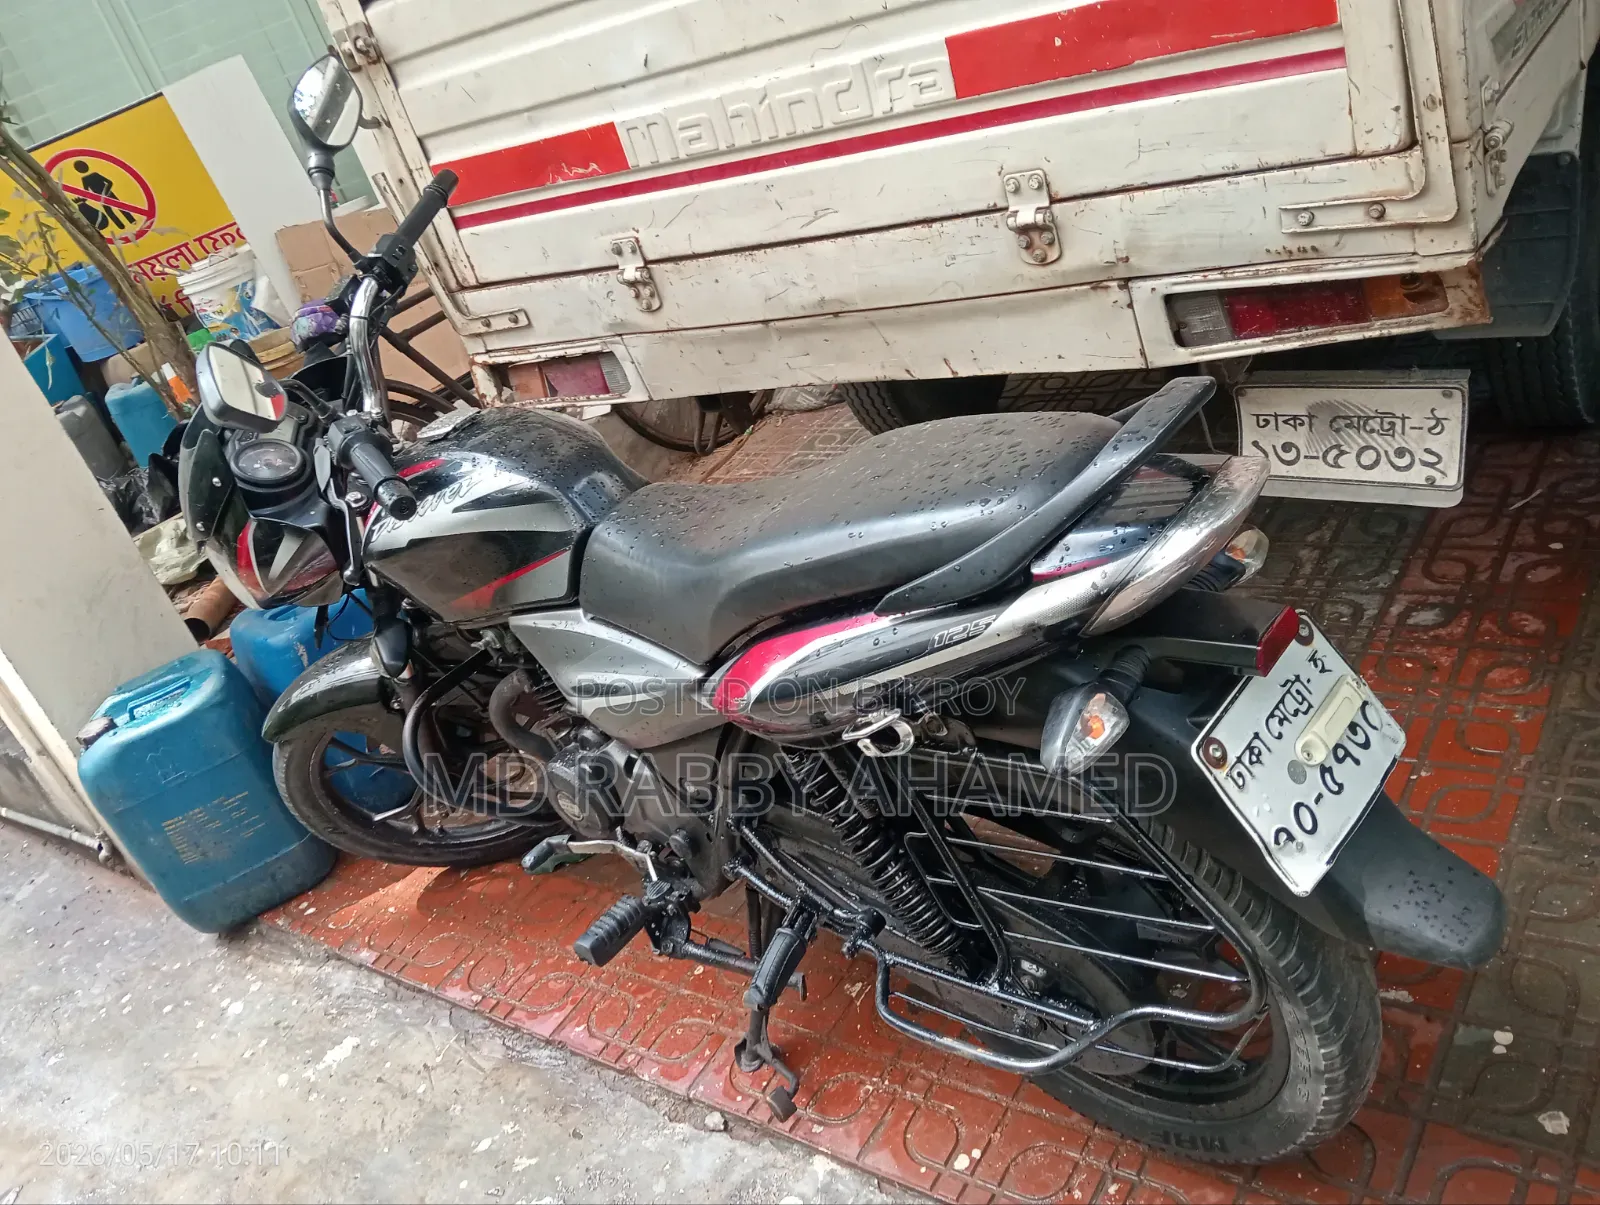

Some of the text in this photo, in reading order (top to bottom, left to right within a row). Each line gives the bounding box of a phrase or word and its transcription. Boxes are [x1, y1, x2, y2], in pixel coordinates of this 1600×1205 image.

[620, 58, 949, 169] mahindra
[1251, 412, 1317, 432] ঢাকা
[934, 615, 996, 648] 125
[1225, 732, 1272, 790] ঢাকা
